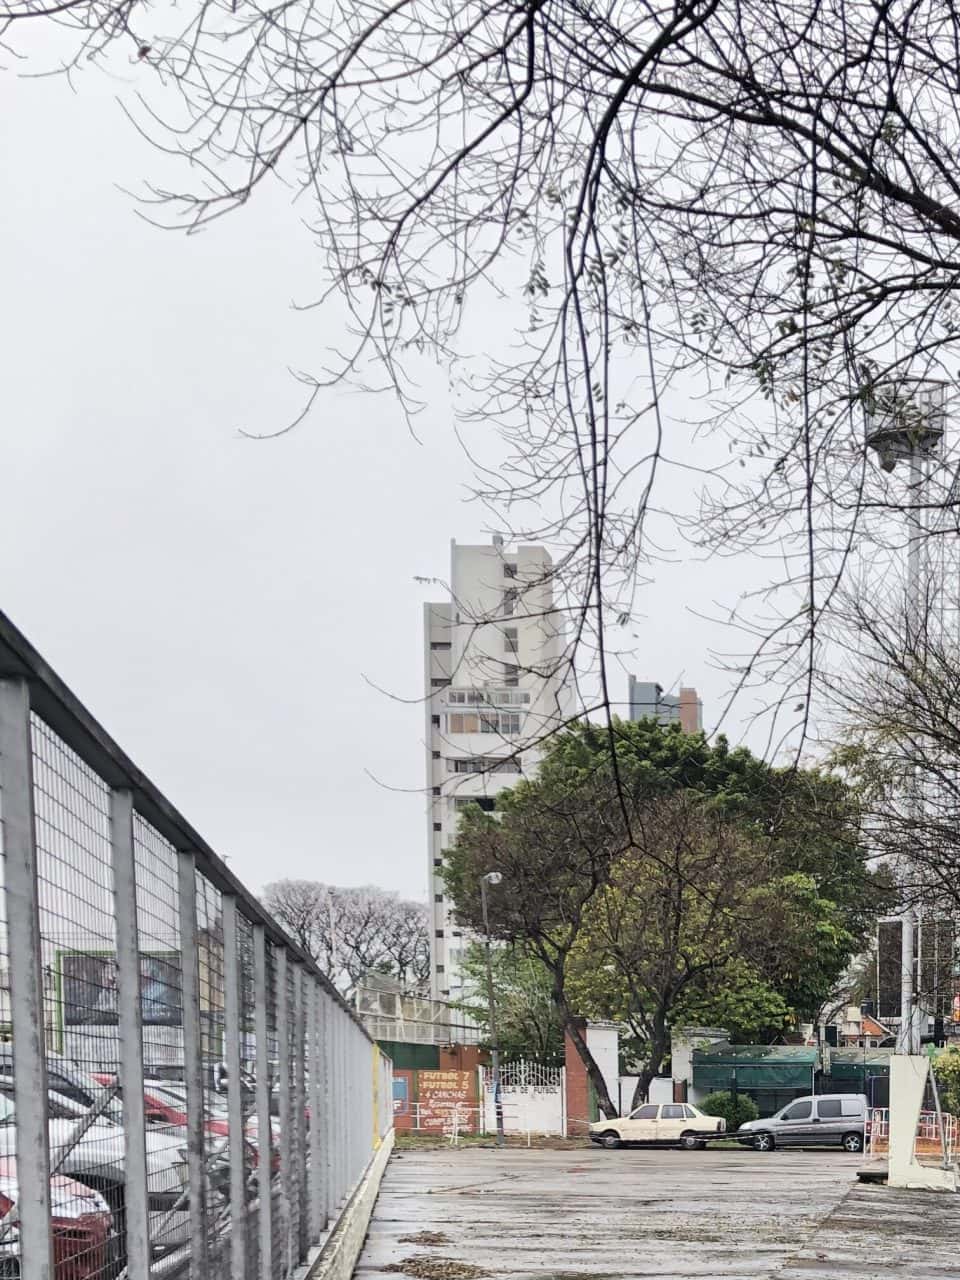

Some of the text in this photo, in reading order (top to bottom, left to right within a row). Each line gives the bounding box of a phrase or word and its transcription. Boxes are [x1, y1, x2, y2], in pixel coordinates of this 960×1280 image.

[463, 1071, 470, 1080] 7
[461, 1081, 469, 1089] 5
[520, 1086, 528, 1094] DE
